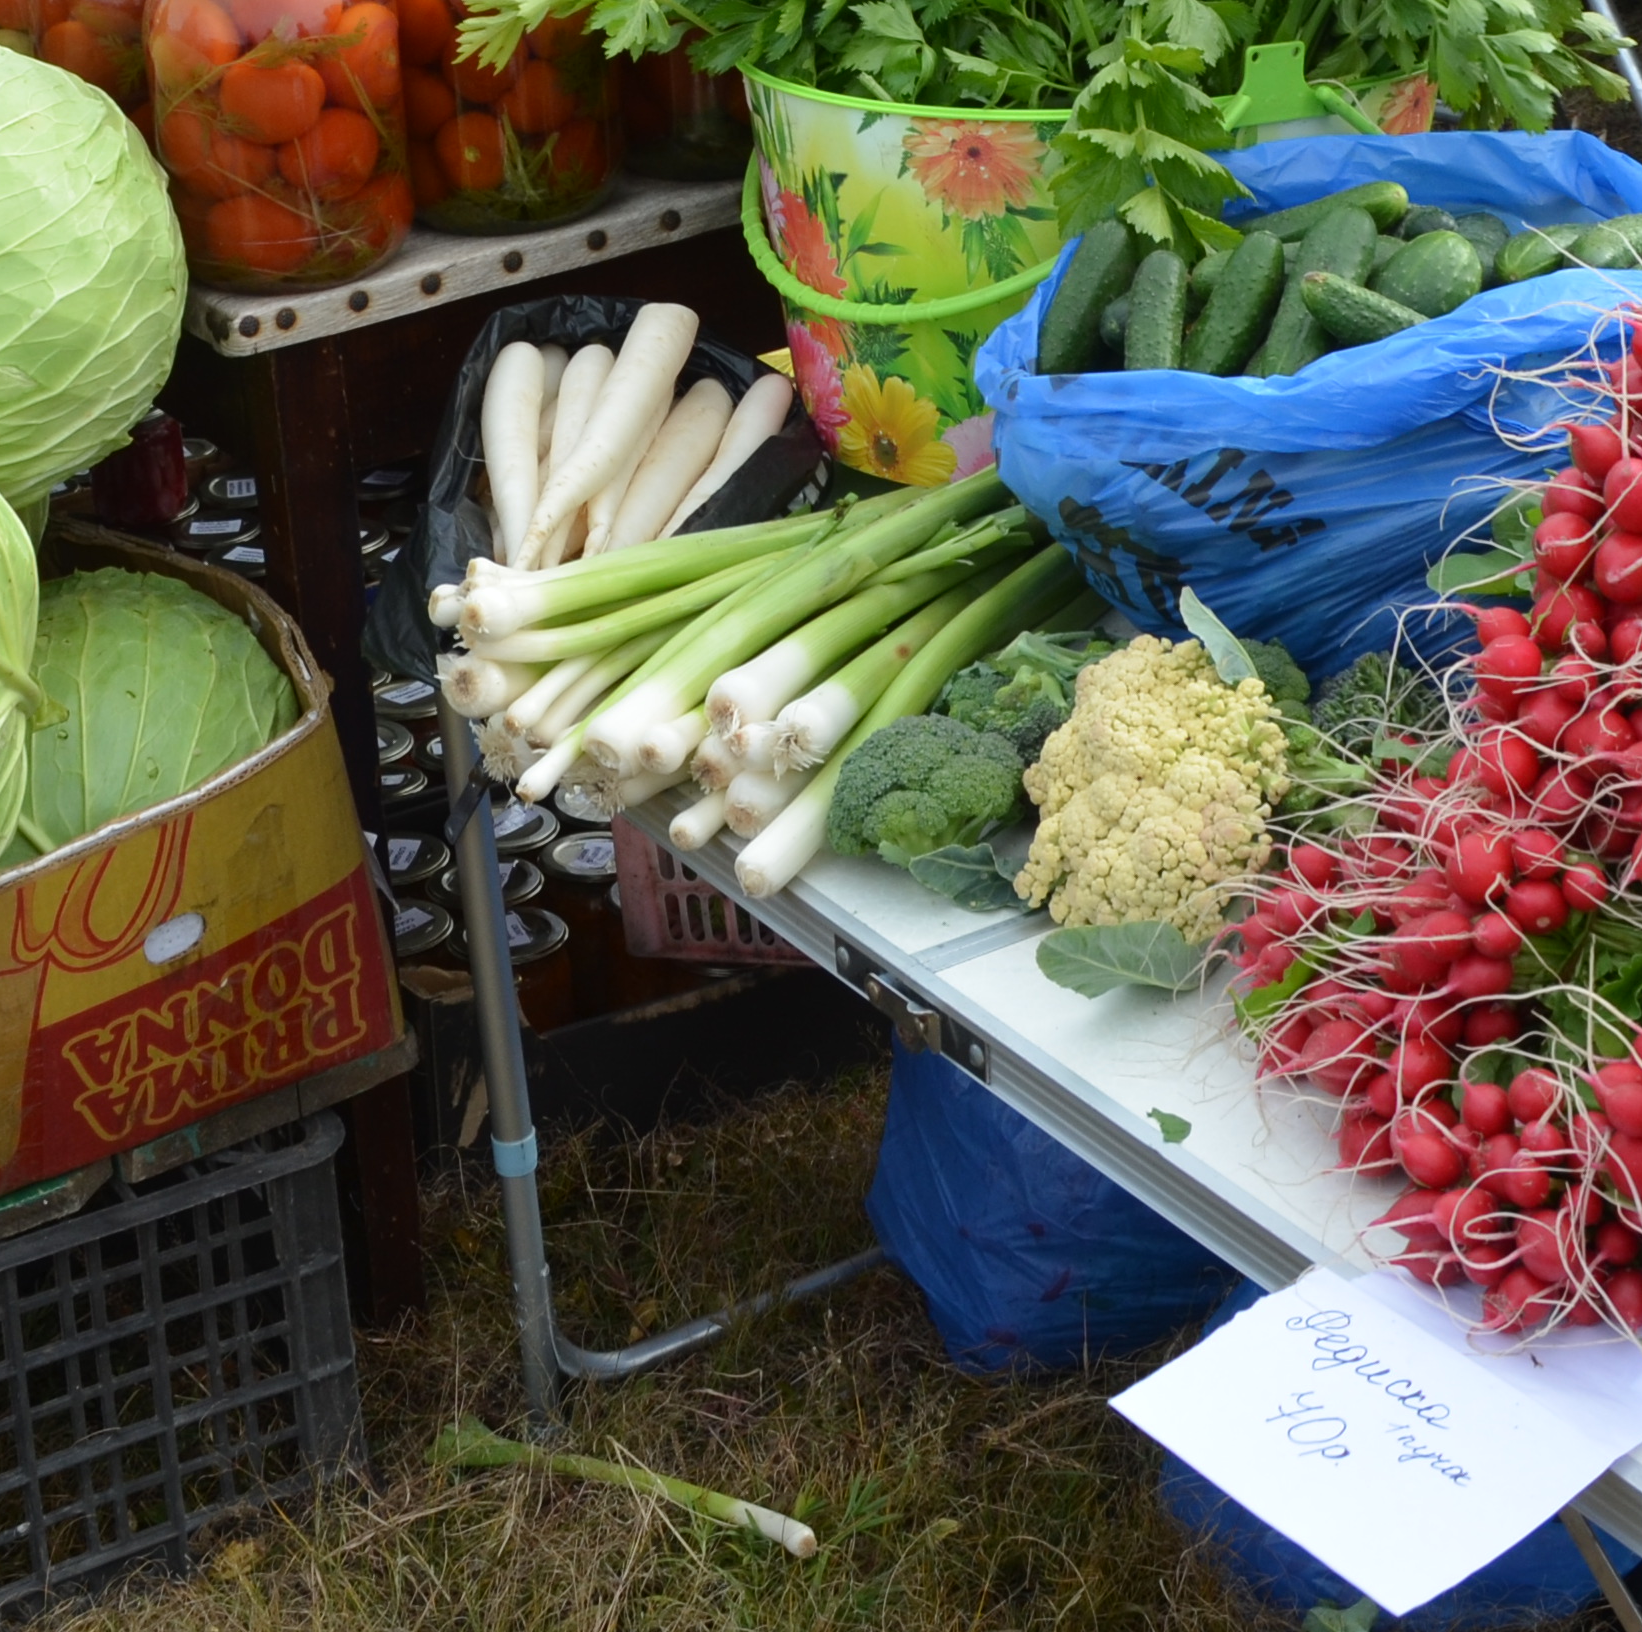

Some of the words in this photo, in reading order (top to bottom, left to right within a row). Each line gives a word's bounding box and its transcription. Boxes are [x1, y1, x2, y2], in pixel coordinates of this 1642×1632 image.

[61, 902, 362, 1091] DONNA
[73, 974, 368, 1142] PRIMA
[1285, 1308, 1453, 1432] Редиска
